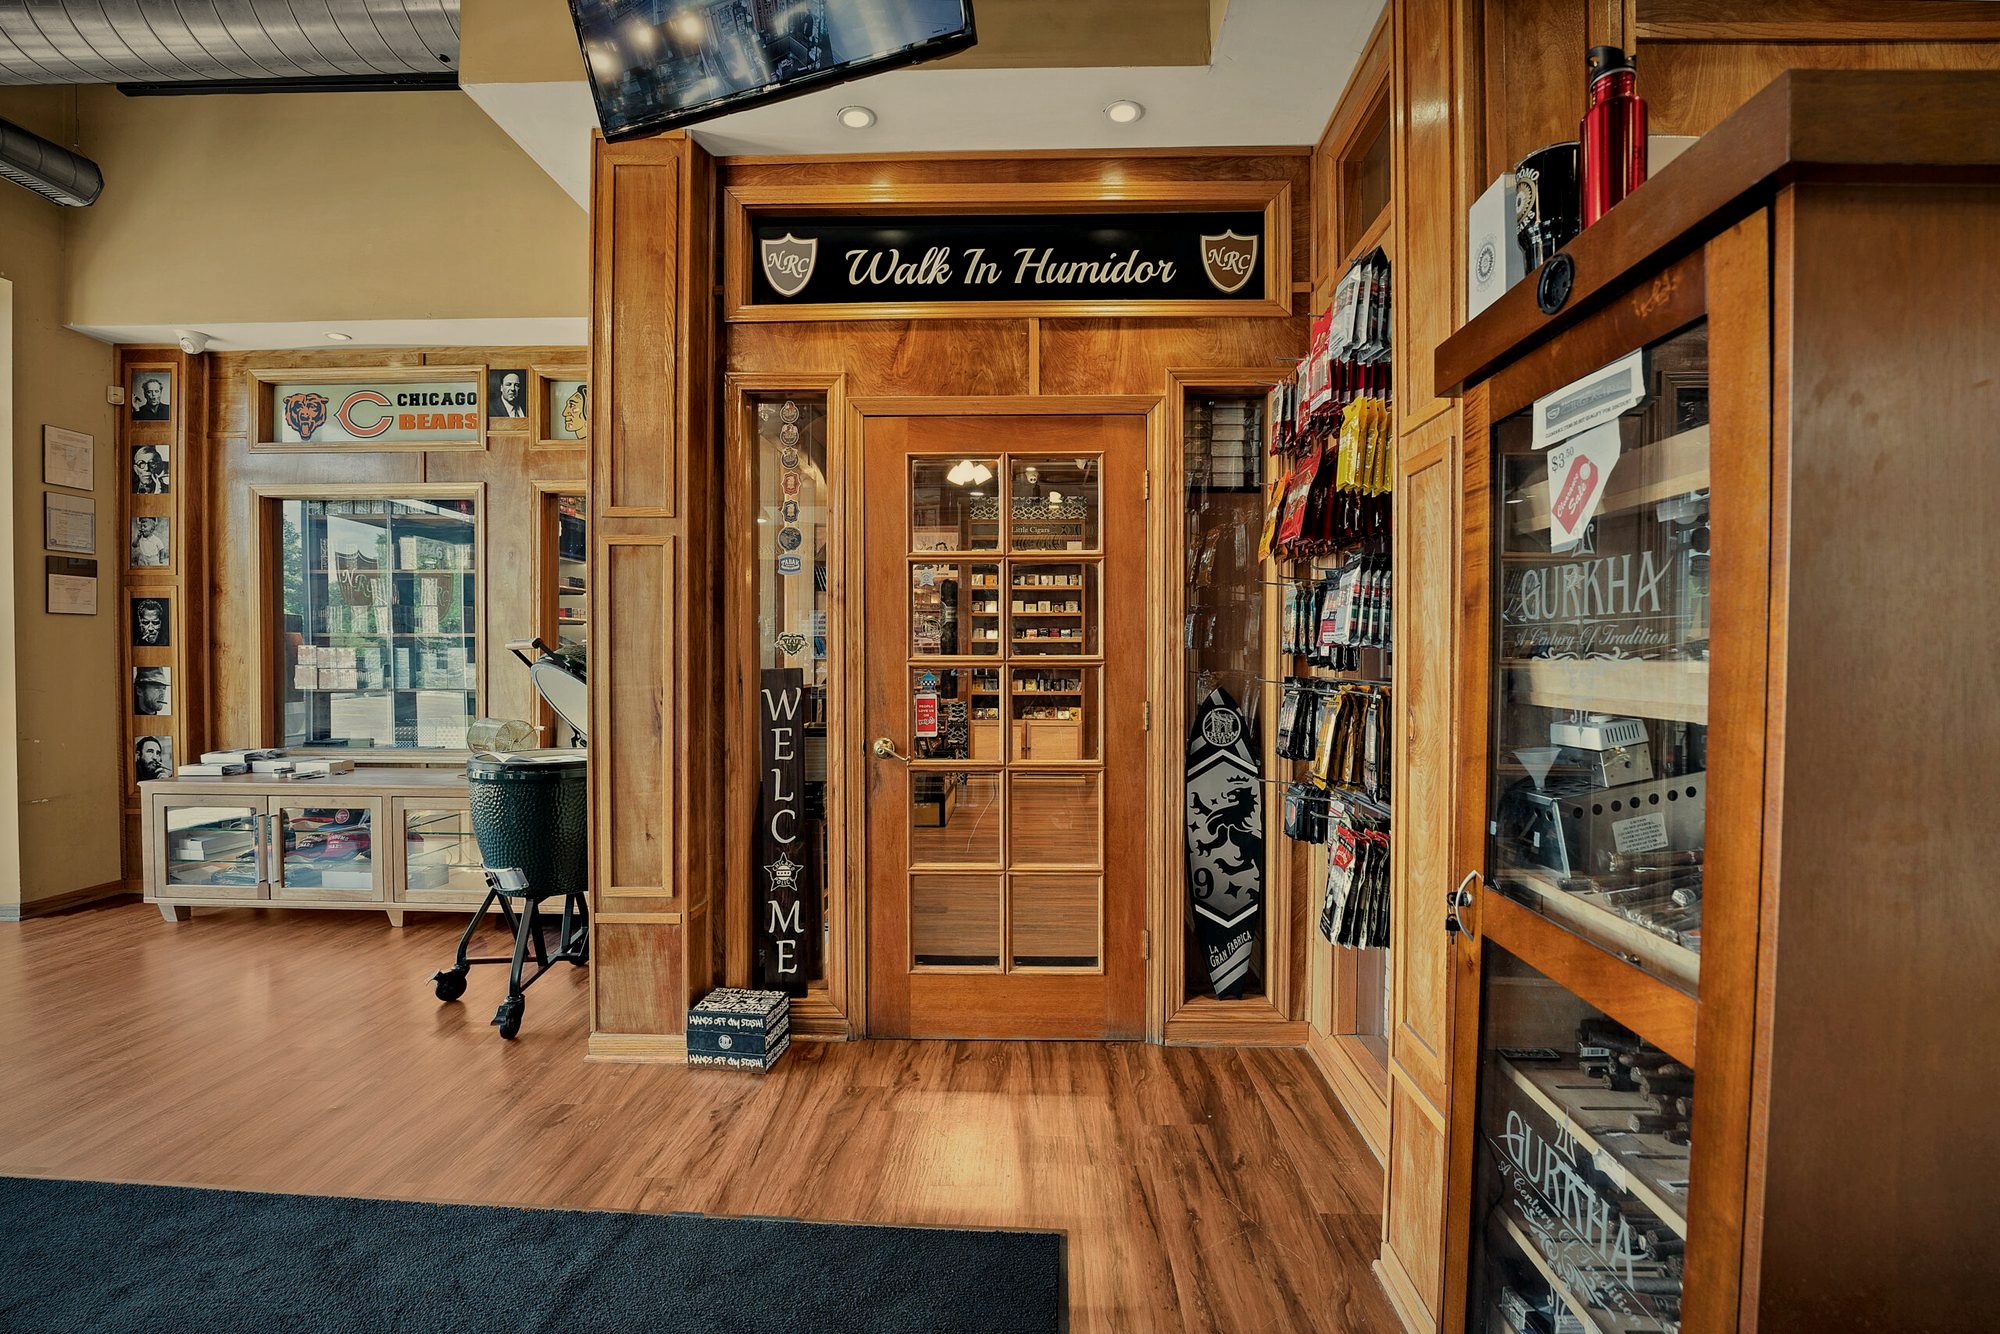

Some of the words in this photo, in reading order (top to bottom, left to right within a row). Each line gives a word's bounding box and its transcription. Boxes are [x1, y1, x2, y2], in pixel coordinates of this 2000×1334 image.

[767, 250, 810, 278] NRC
[845, 246, 953, 286] Walk
[963, 248, 1002, 285] In
[1013, 247, 1177, 285] Humidor
[1207, 246, 1251, 275] NRC
[397, 391, 477, 407] CHICAGO
[398, 412, 478, 430] BEARS
[1029, 526, 1051, 535] Cigars
[1521, 551, 1674, 620] GURKHA
[1530, 626, 1575, 650] Century
[1579, 625, 1598, 652] Of
[1598, 625, 1670, 647] Tradition
[1193, 867, 1215, 899] 9
[1208, 944, 1219, 955] LA
[1209, 950, 1228, 968] GRAN
[1226, 930, 1252, 955] FABRICA
[689, 1015, 713, 1028] HANDS
[689, 1054, 713, 1066] HANDS
[1513, 1172, 1557, 1231] Century
